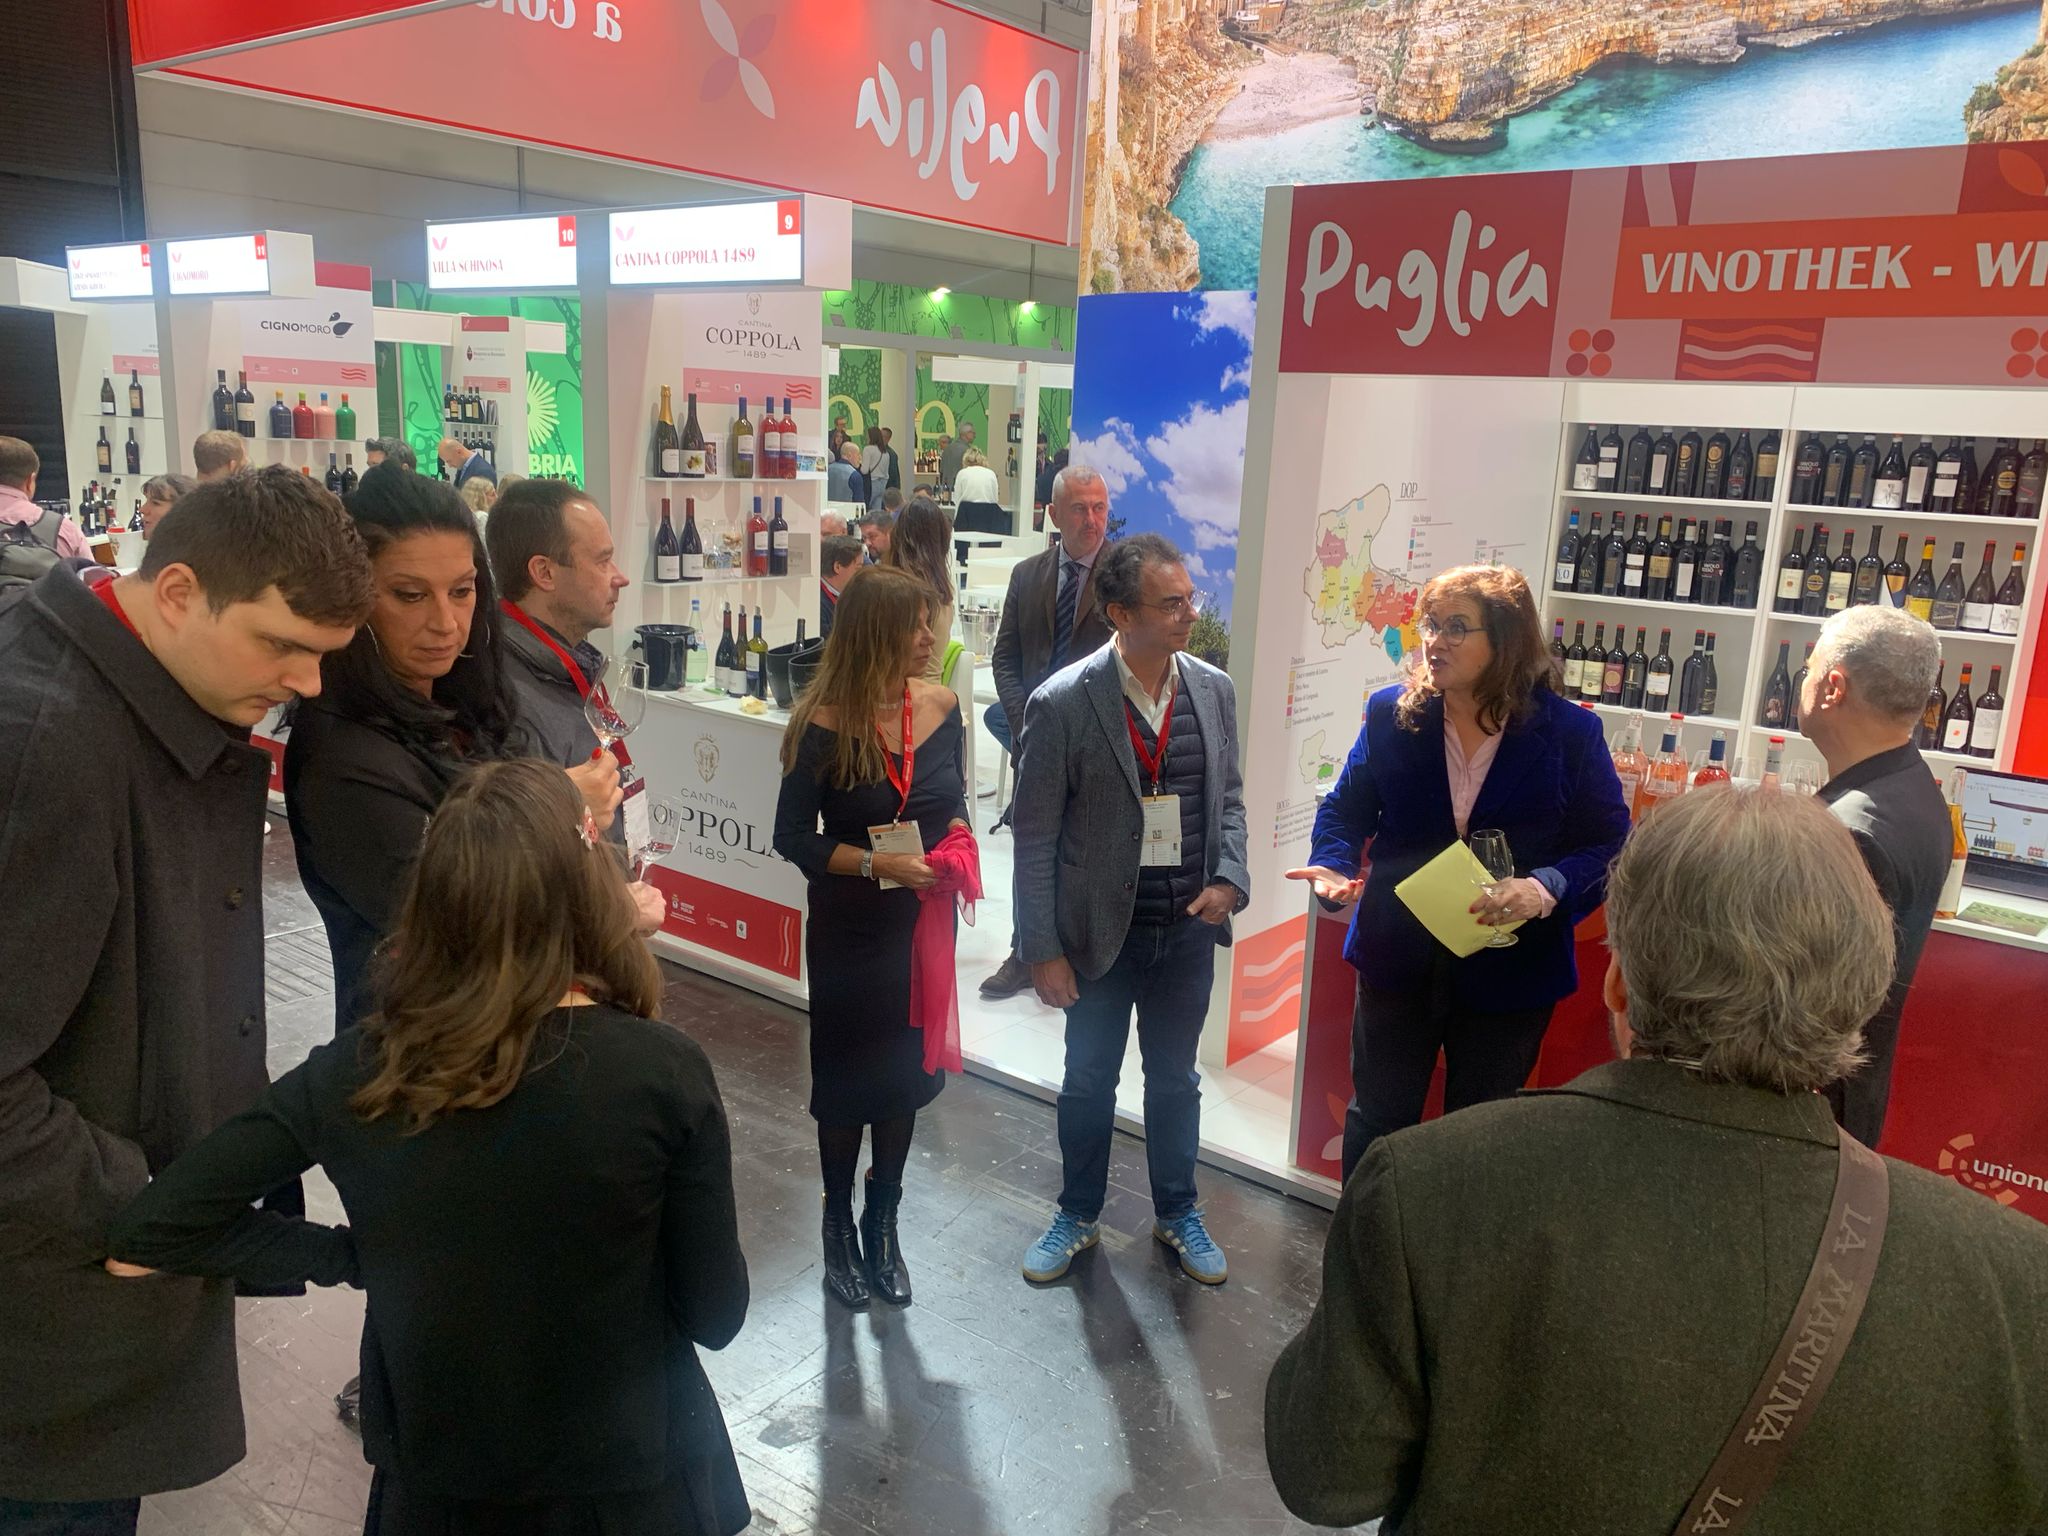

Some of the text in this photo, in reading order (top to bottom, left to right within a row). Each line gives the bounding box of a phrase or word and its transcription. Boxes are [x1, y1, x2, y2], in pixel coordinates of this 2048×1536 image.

[784, 214, 794, 230] 9
[562, 229, 574, 242] 10
[257, 245, 266, 257] 11
[616, 247, 755, 267] CANTINA COPPOLA 1489
[433, 259, 503, 273] VILLA SCHINOSA
[1640, 245, 1912, 293] VINOTHEK
[1301, 209, 1548, 347] Puglia
[260, 320, 331, 335] CIGNOMORO
[738, 320, 773, 329] CANTINA
[706, 327, 802, 351] COPPOLA
[743, 350, 767, 359] 1489
[1400, 482, 1418, 498] DOP
[680, 788, 738, 811] CANTINA
[688, 842, 727, 864] 1489
[1744, 1263, 1854, 1446] MARTINA
